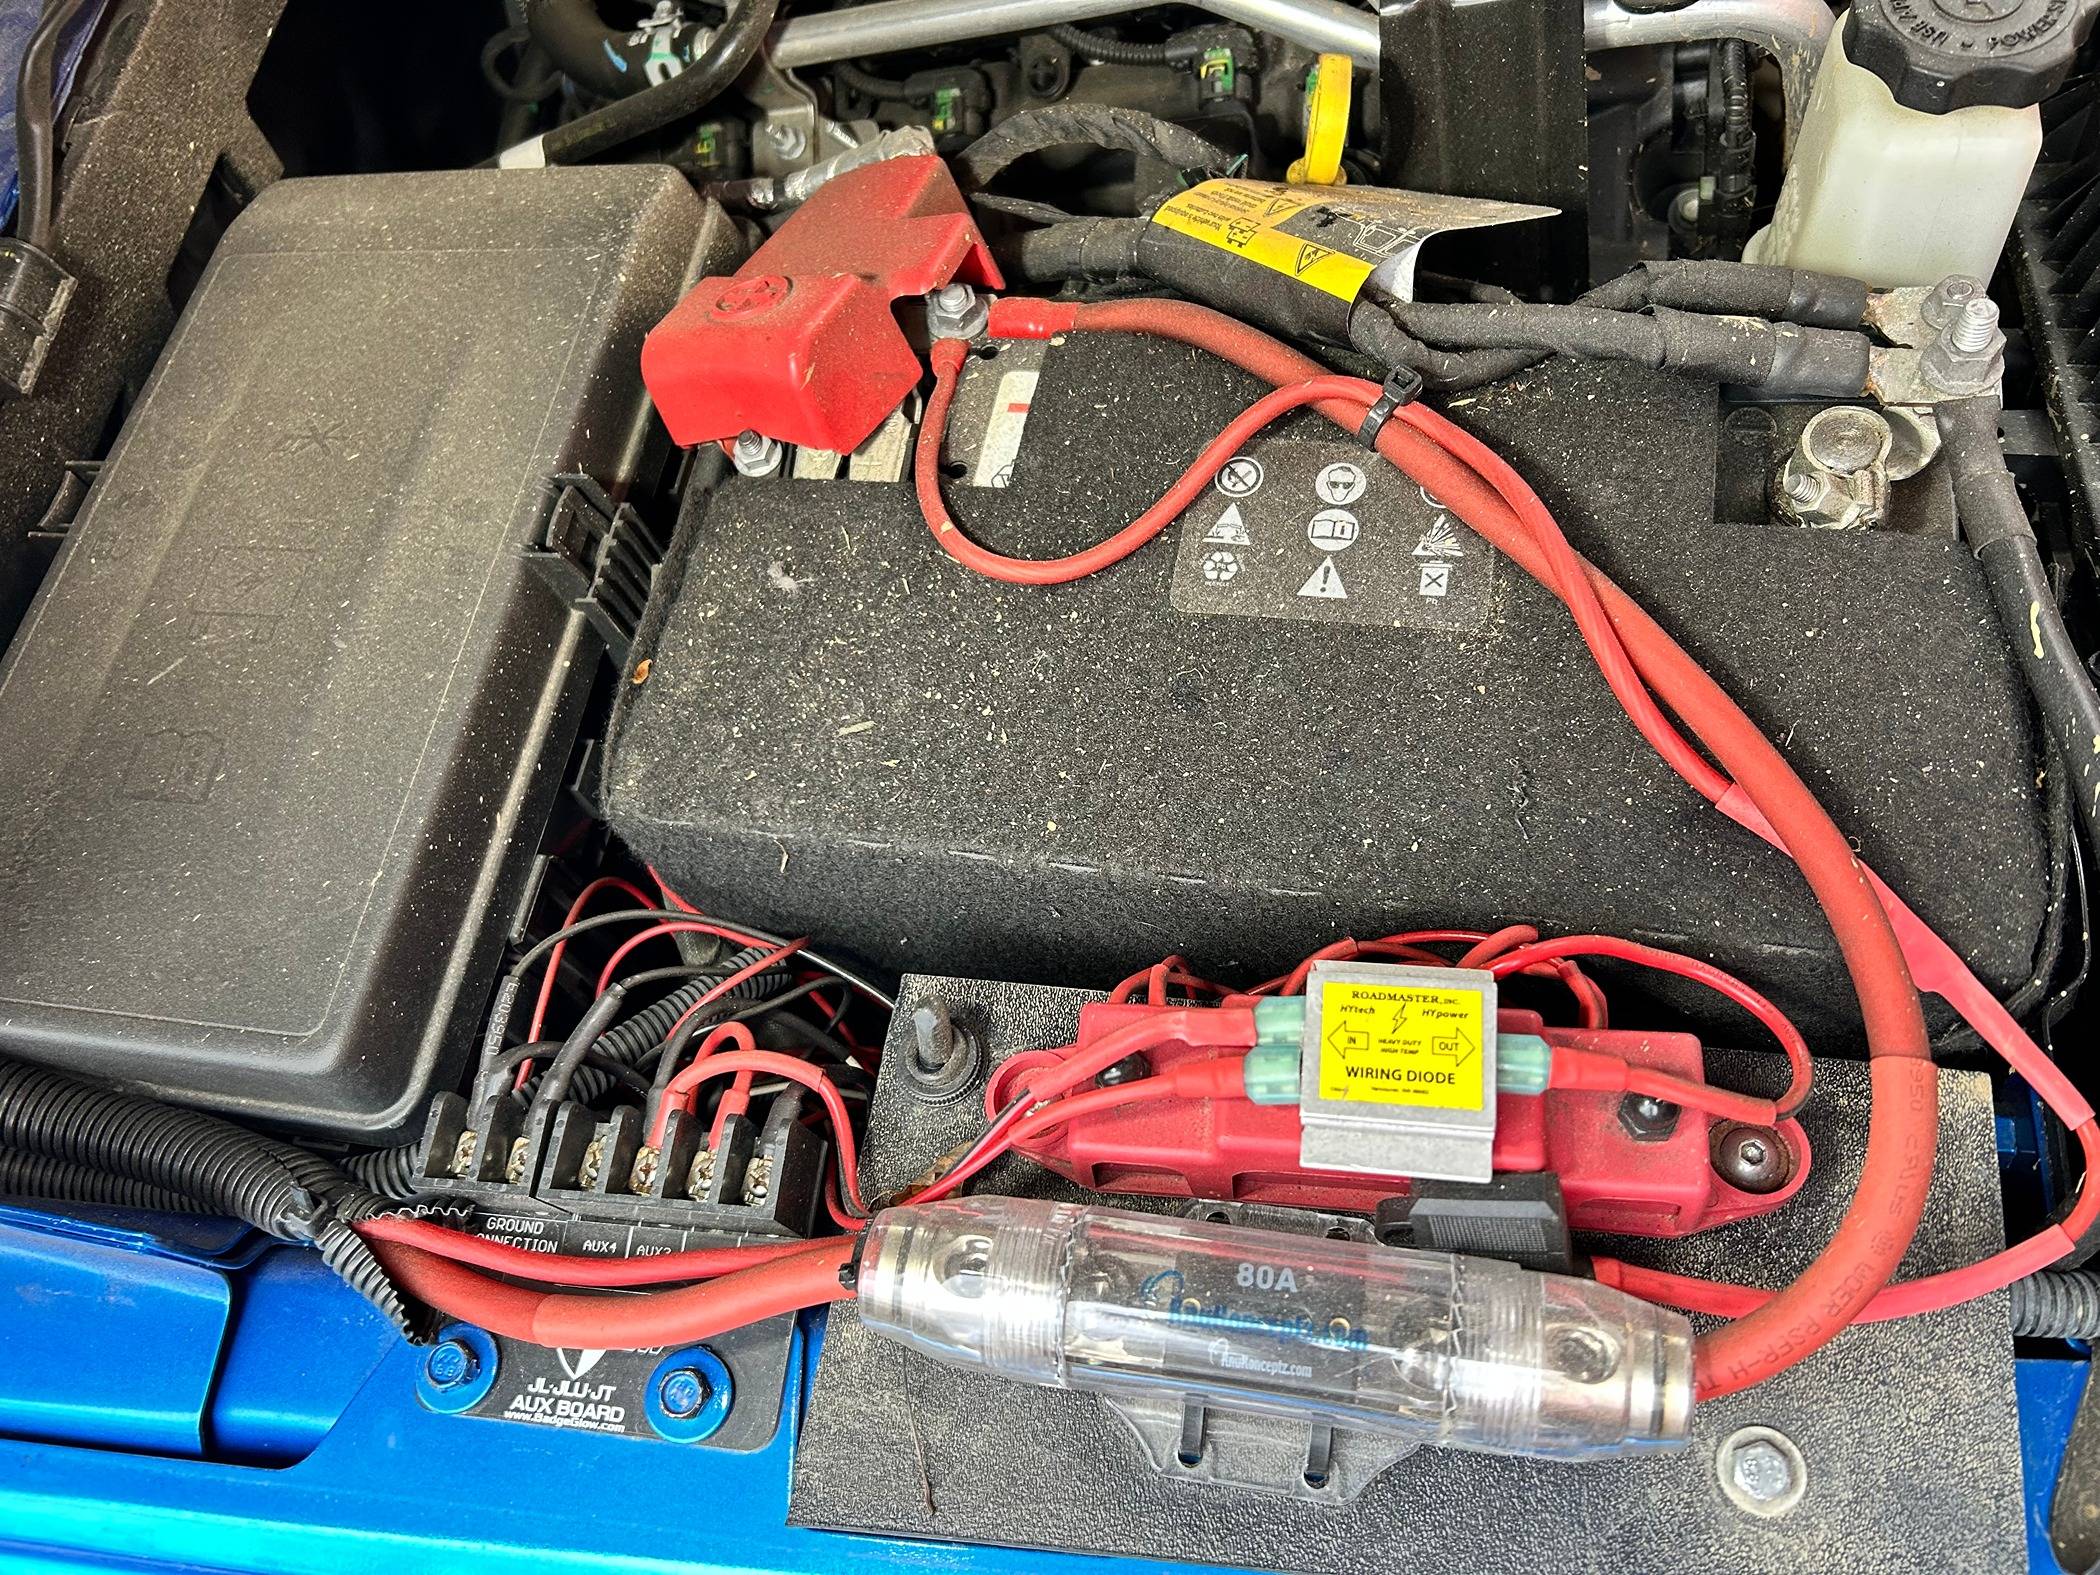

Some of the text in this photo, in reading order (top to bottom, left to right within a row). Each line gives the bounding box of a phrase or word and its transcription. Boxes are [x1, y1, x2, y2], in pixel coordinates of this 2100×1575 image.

[1340, 1003, 1375, 1014] HYtech
[1422, 1009, 1469, 1019] HYpower
[1347, 1036, 1357, 1044] IN
[1439, 1041, 1460, 1051] OUT
[1345, 1066, 1456, 1085] WIRING DIODE
[486, 1217, 545, 1235] GROUND
[582, 1239, 617, 1254] AUX4
[1236, 1263, 1298, 1293] 80A
[509, 1394, 626, 1423] AUX BOARD
[503, 1410, 626, 1433] www.BadgeGlow.com
